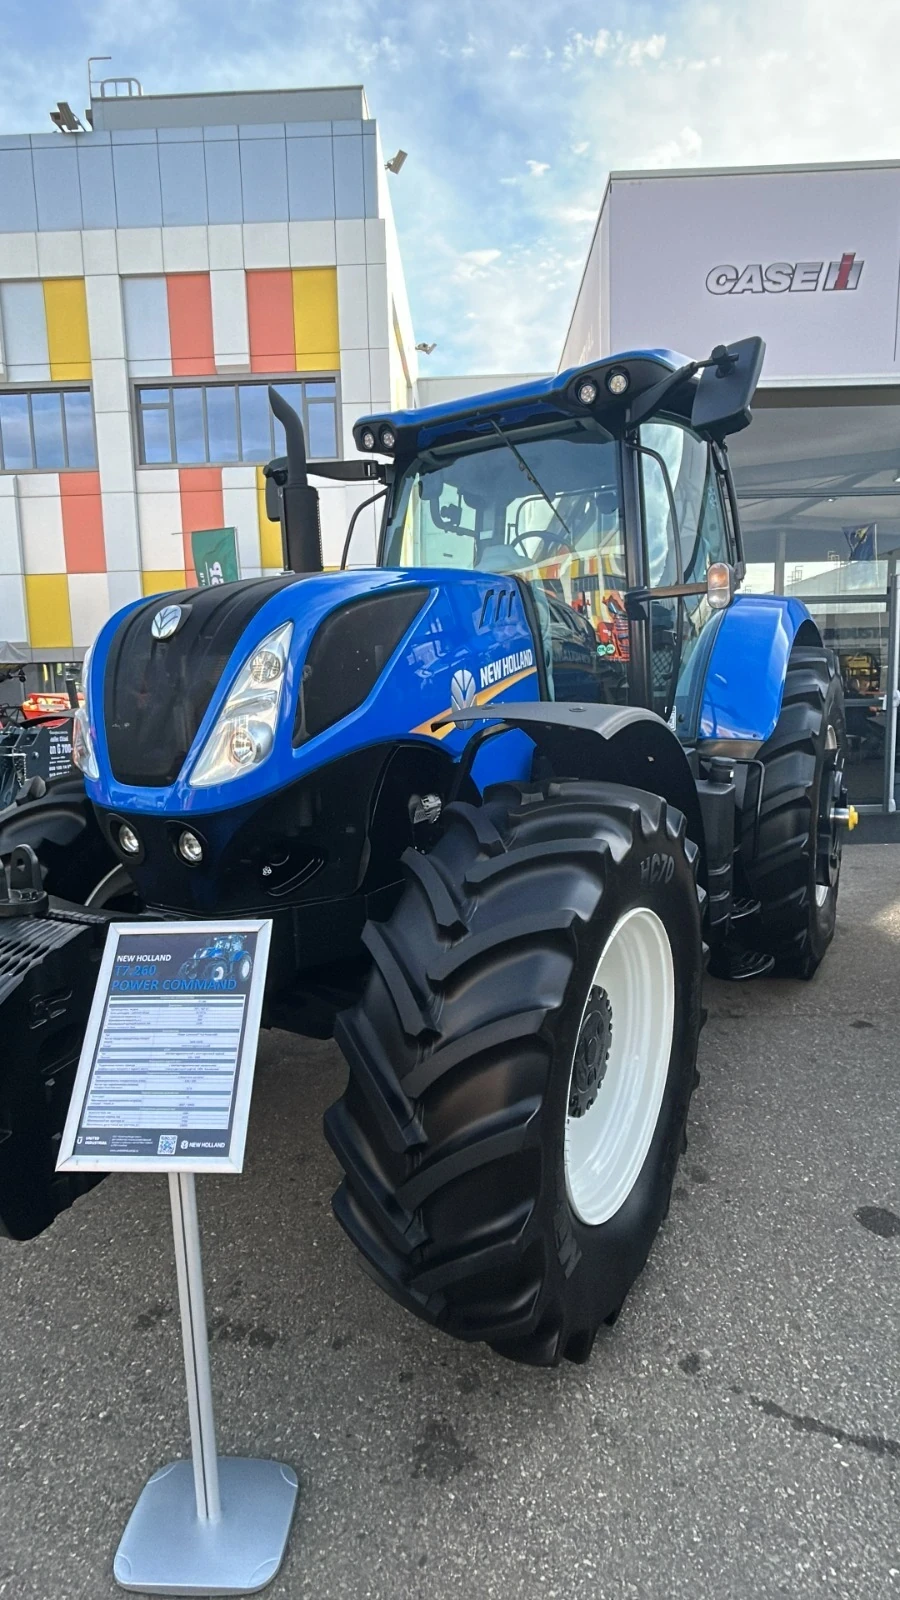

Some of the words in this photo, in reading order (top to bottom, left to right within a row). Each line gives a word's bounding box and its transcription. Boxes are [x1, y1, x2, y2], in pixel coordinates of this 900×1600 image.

[706, 262, 823, 295] CASE
[480, 659, 502, 688] NEW
[502, 649, 533, 677] HOLLAND
[116, 955, 136, 963] NEW
[136, 954, 172, 962] HOLLAND
[114, 964, 157, 977] T7.260
[111, 979, 159, 992] POWER
[162, 978, 237, 991] COMMAND
